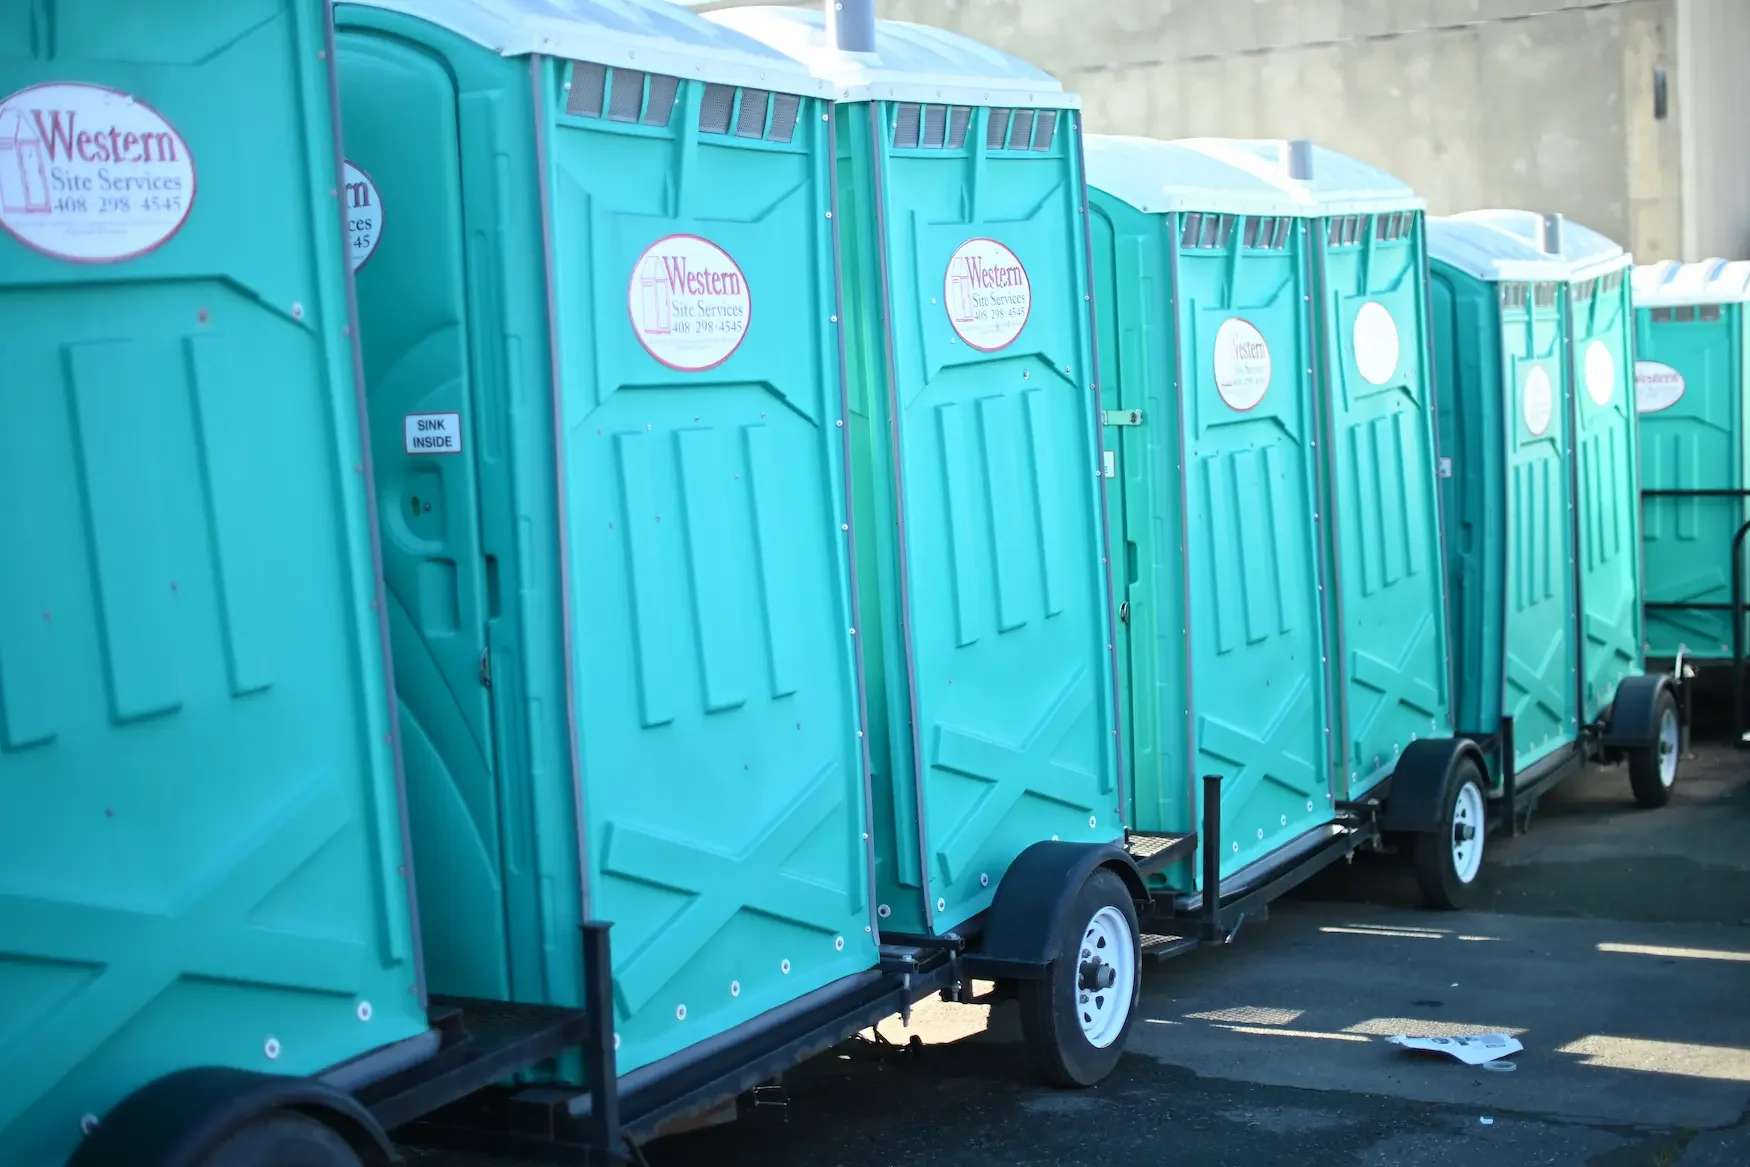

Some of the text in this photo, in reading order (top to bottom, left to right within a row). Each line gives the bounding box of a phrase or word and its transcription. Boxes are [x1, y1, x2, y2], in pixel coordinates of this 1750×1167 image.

[30, 109, 178, 164] Western
[51, 167, 182, 191] Site Services
[54, 196, 181, 213] 408 298 4545
[353, 234, 371, 248] 45
[662, 256, 741, 296] Western
[965, 256, 1023, 289] Western
[972, 292, 1025, 308] Site Services
[672, 300, 743, 317] Site Services
[974, 307, 1025, 320] 408 298 4545
[672, 320, 742, 333] 408 298 4545
[417, 419, 446, 431] SINK
[412, 436, 452, 448] INSIDE
